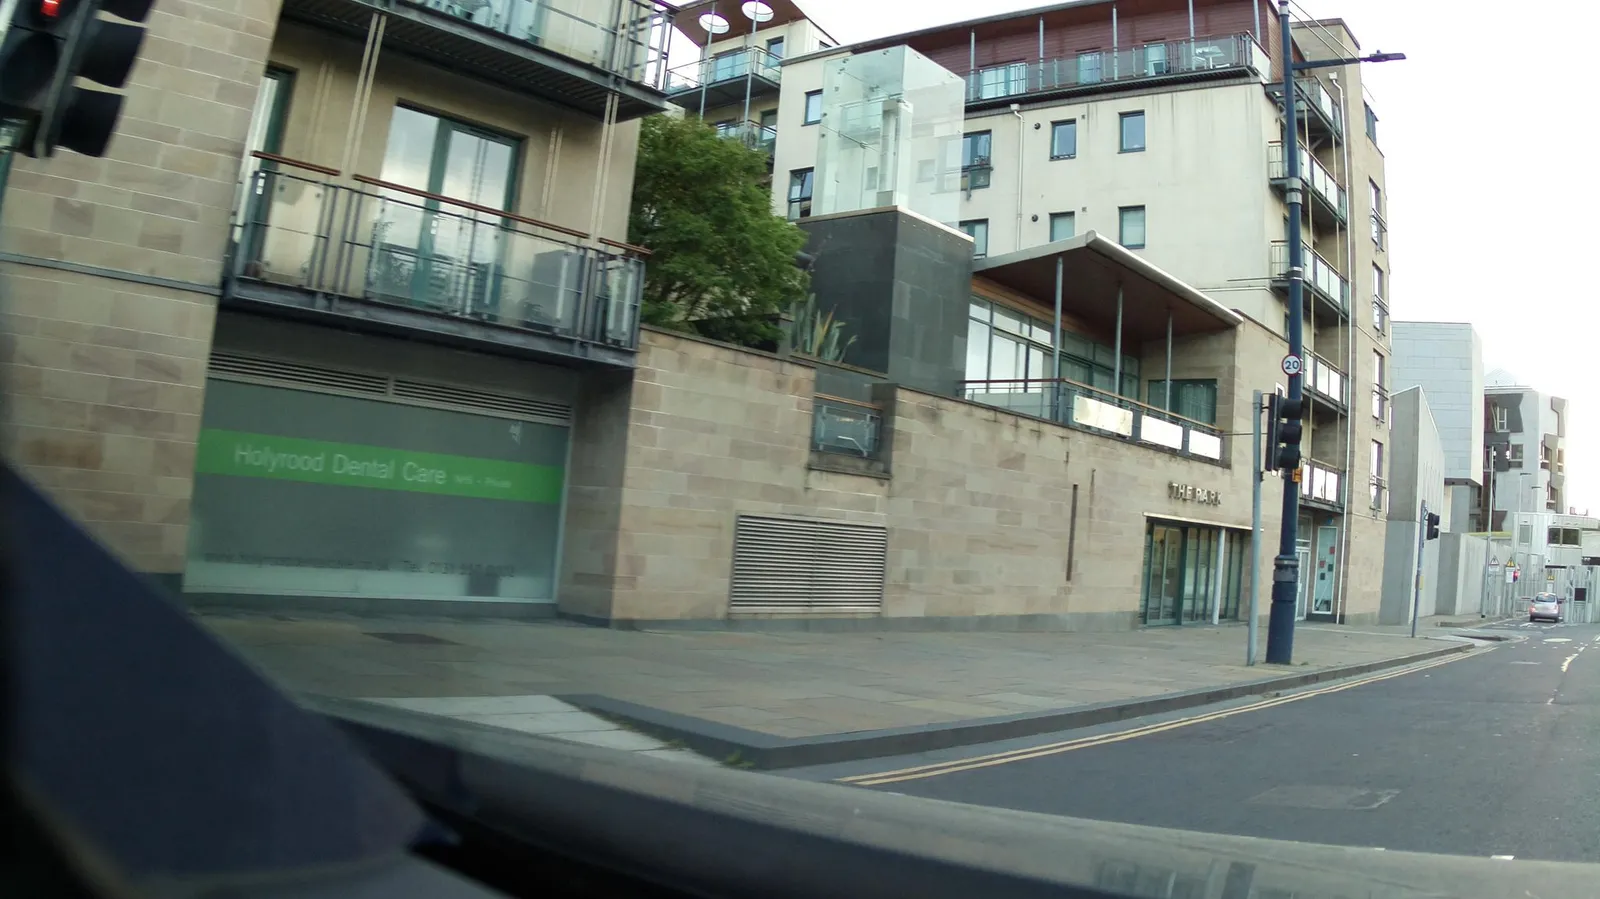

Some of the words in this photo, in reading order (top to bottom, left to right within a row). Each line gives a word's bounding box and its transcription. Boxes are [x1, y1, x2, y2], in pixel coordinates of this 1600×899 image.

[1285, 360, 1300, 370] 20
[234, 444, 325, 473] Holyrood
[332, 453, 395, 479] Dental
[402, 461, 447, 485] Care
[1170, 482, 1194, 500] THE
[1196, 488, 1222, 506] PARK
